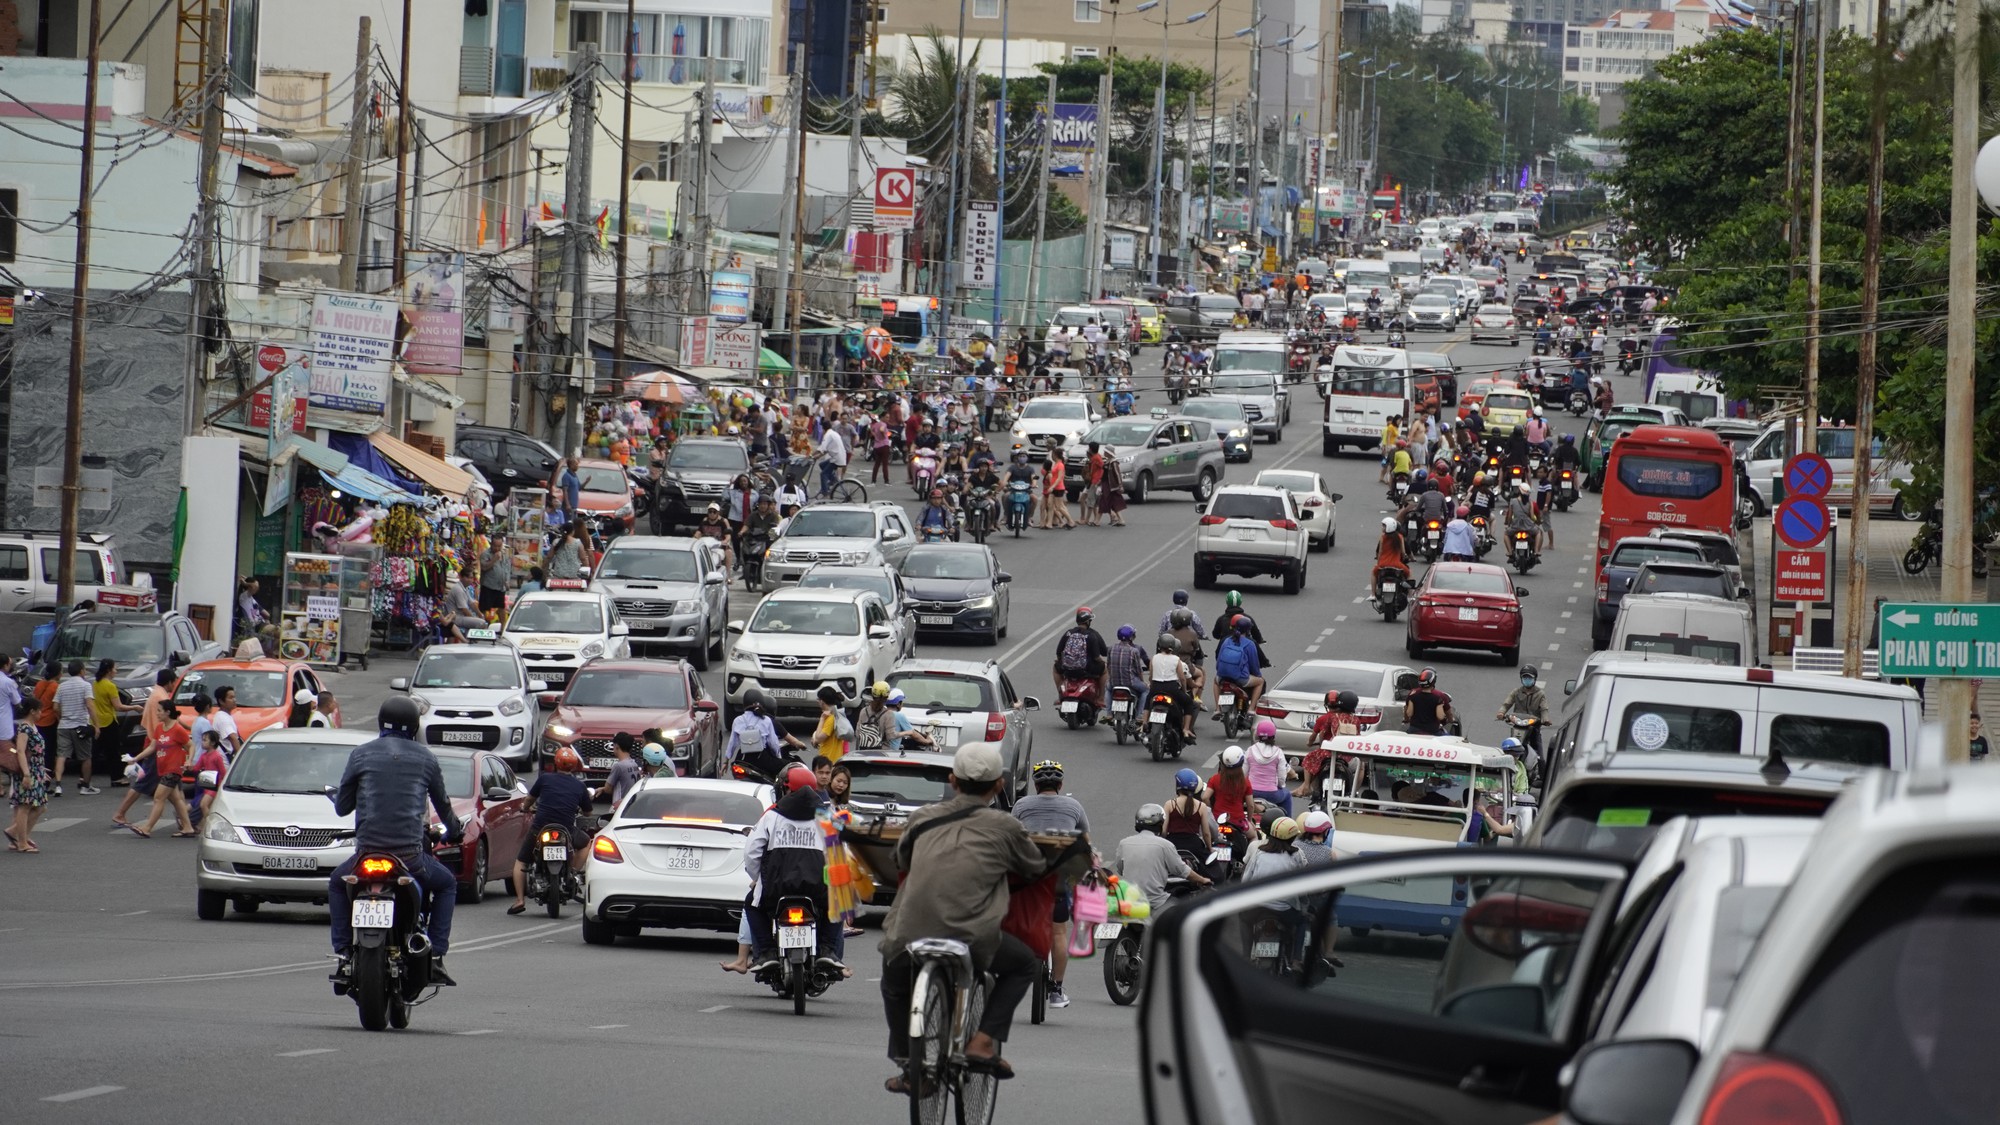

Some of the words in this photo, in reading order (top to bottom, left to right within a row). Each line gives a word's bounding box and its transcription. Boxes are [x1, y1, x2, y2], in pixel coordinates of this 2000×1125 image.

[888, 178, 908, 201] K
[859, 283, 879, 298] 41
[442, 328, 460, 336] KIM
[1791, 553, 1810, 566] CẤM
[1885, 640, 1930, 666] PHAN
[1936, 641, 1969, 668] CHU
[676, 848, 694, 858] 72A
[264, 857, 315, 869] 60A-213.40
[668, 858, 700, 869] 328.98
[360, 903, 386, 914] 78-C1
[355, 915, 390, 926] 510.45
[785, 938, 806, 946] 1701
